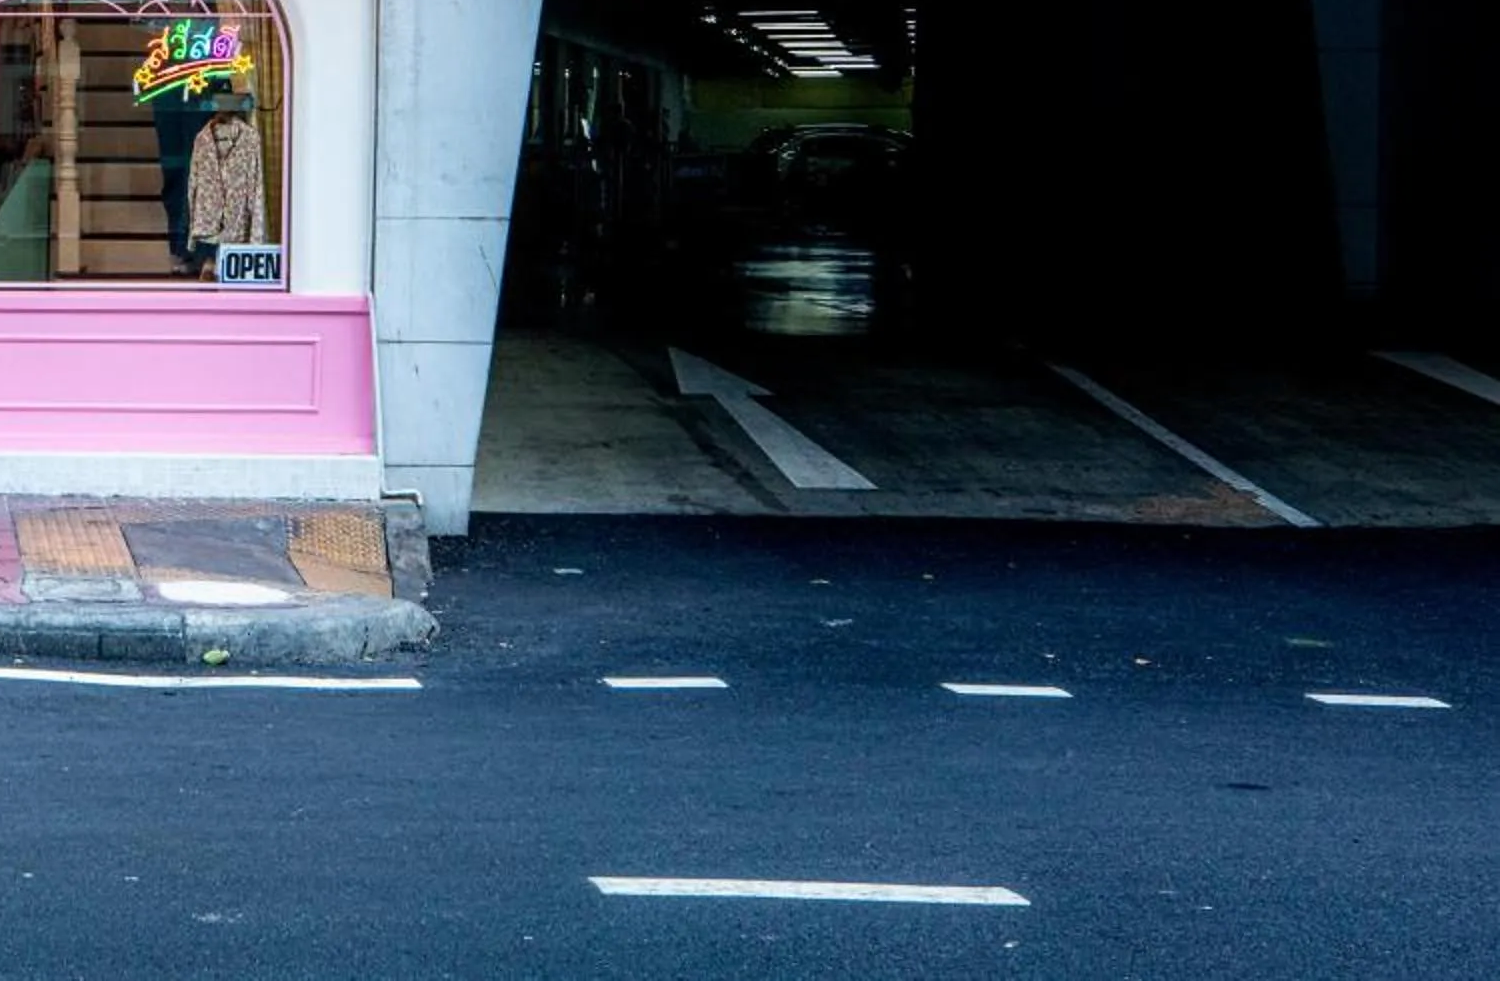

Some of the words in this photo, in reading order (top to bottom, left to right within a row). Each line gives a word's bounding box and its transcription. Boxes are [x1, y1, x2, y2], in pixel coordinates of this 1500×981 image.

[146, 19, 241, 69] สวัสดี
[226, 252, 282, 280] OPEN
